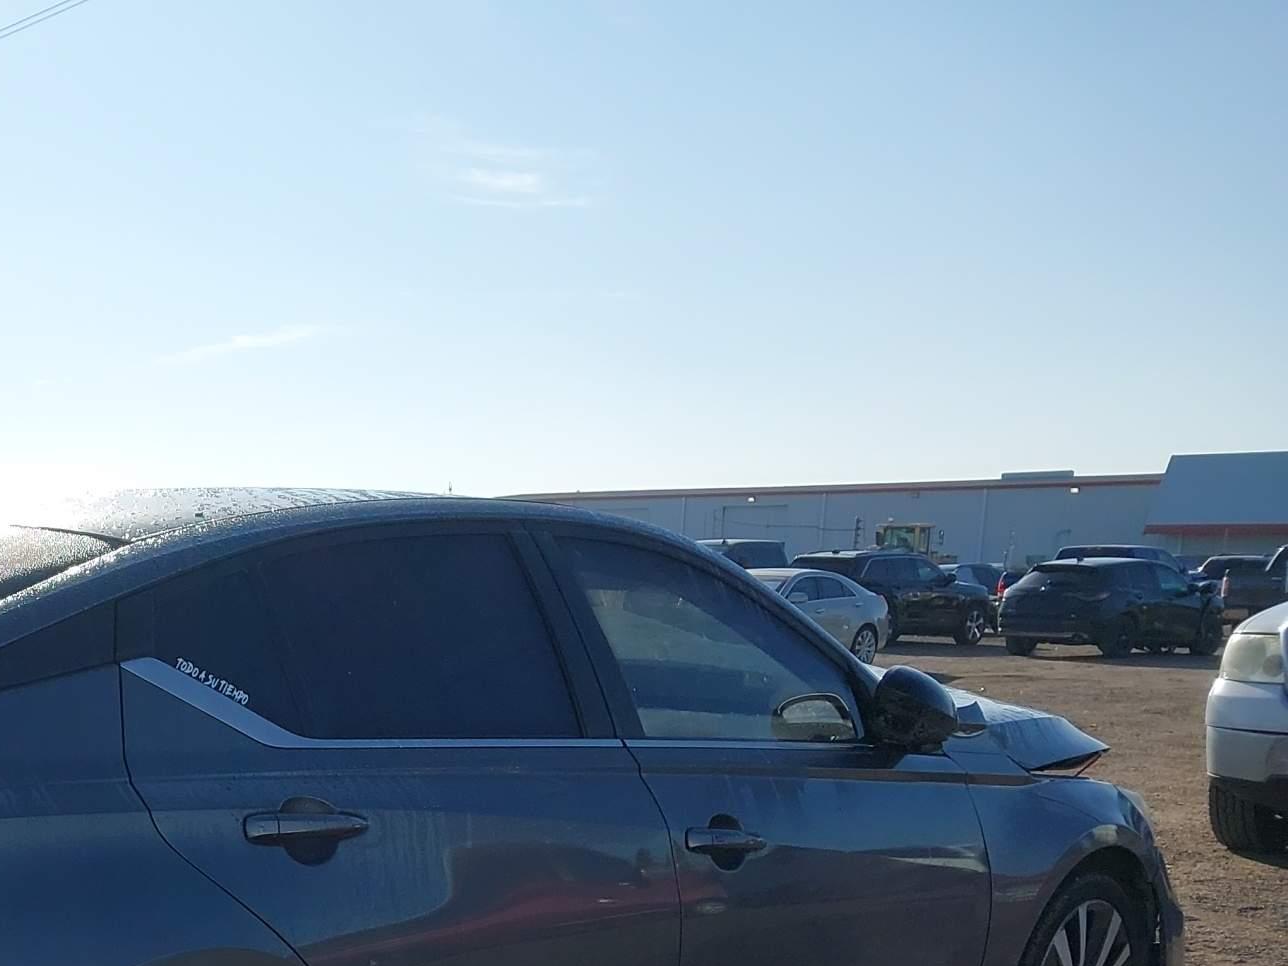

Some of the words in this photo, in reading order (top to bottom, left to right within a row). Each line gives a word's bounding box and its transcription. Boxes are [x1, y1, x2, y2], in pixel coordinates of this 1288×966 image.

[175, 657, 199, 678] TODO
[204, 674, 220, 689] SU
[218, 680, 249, 705] TIEMPO
